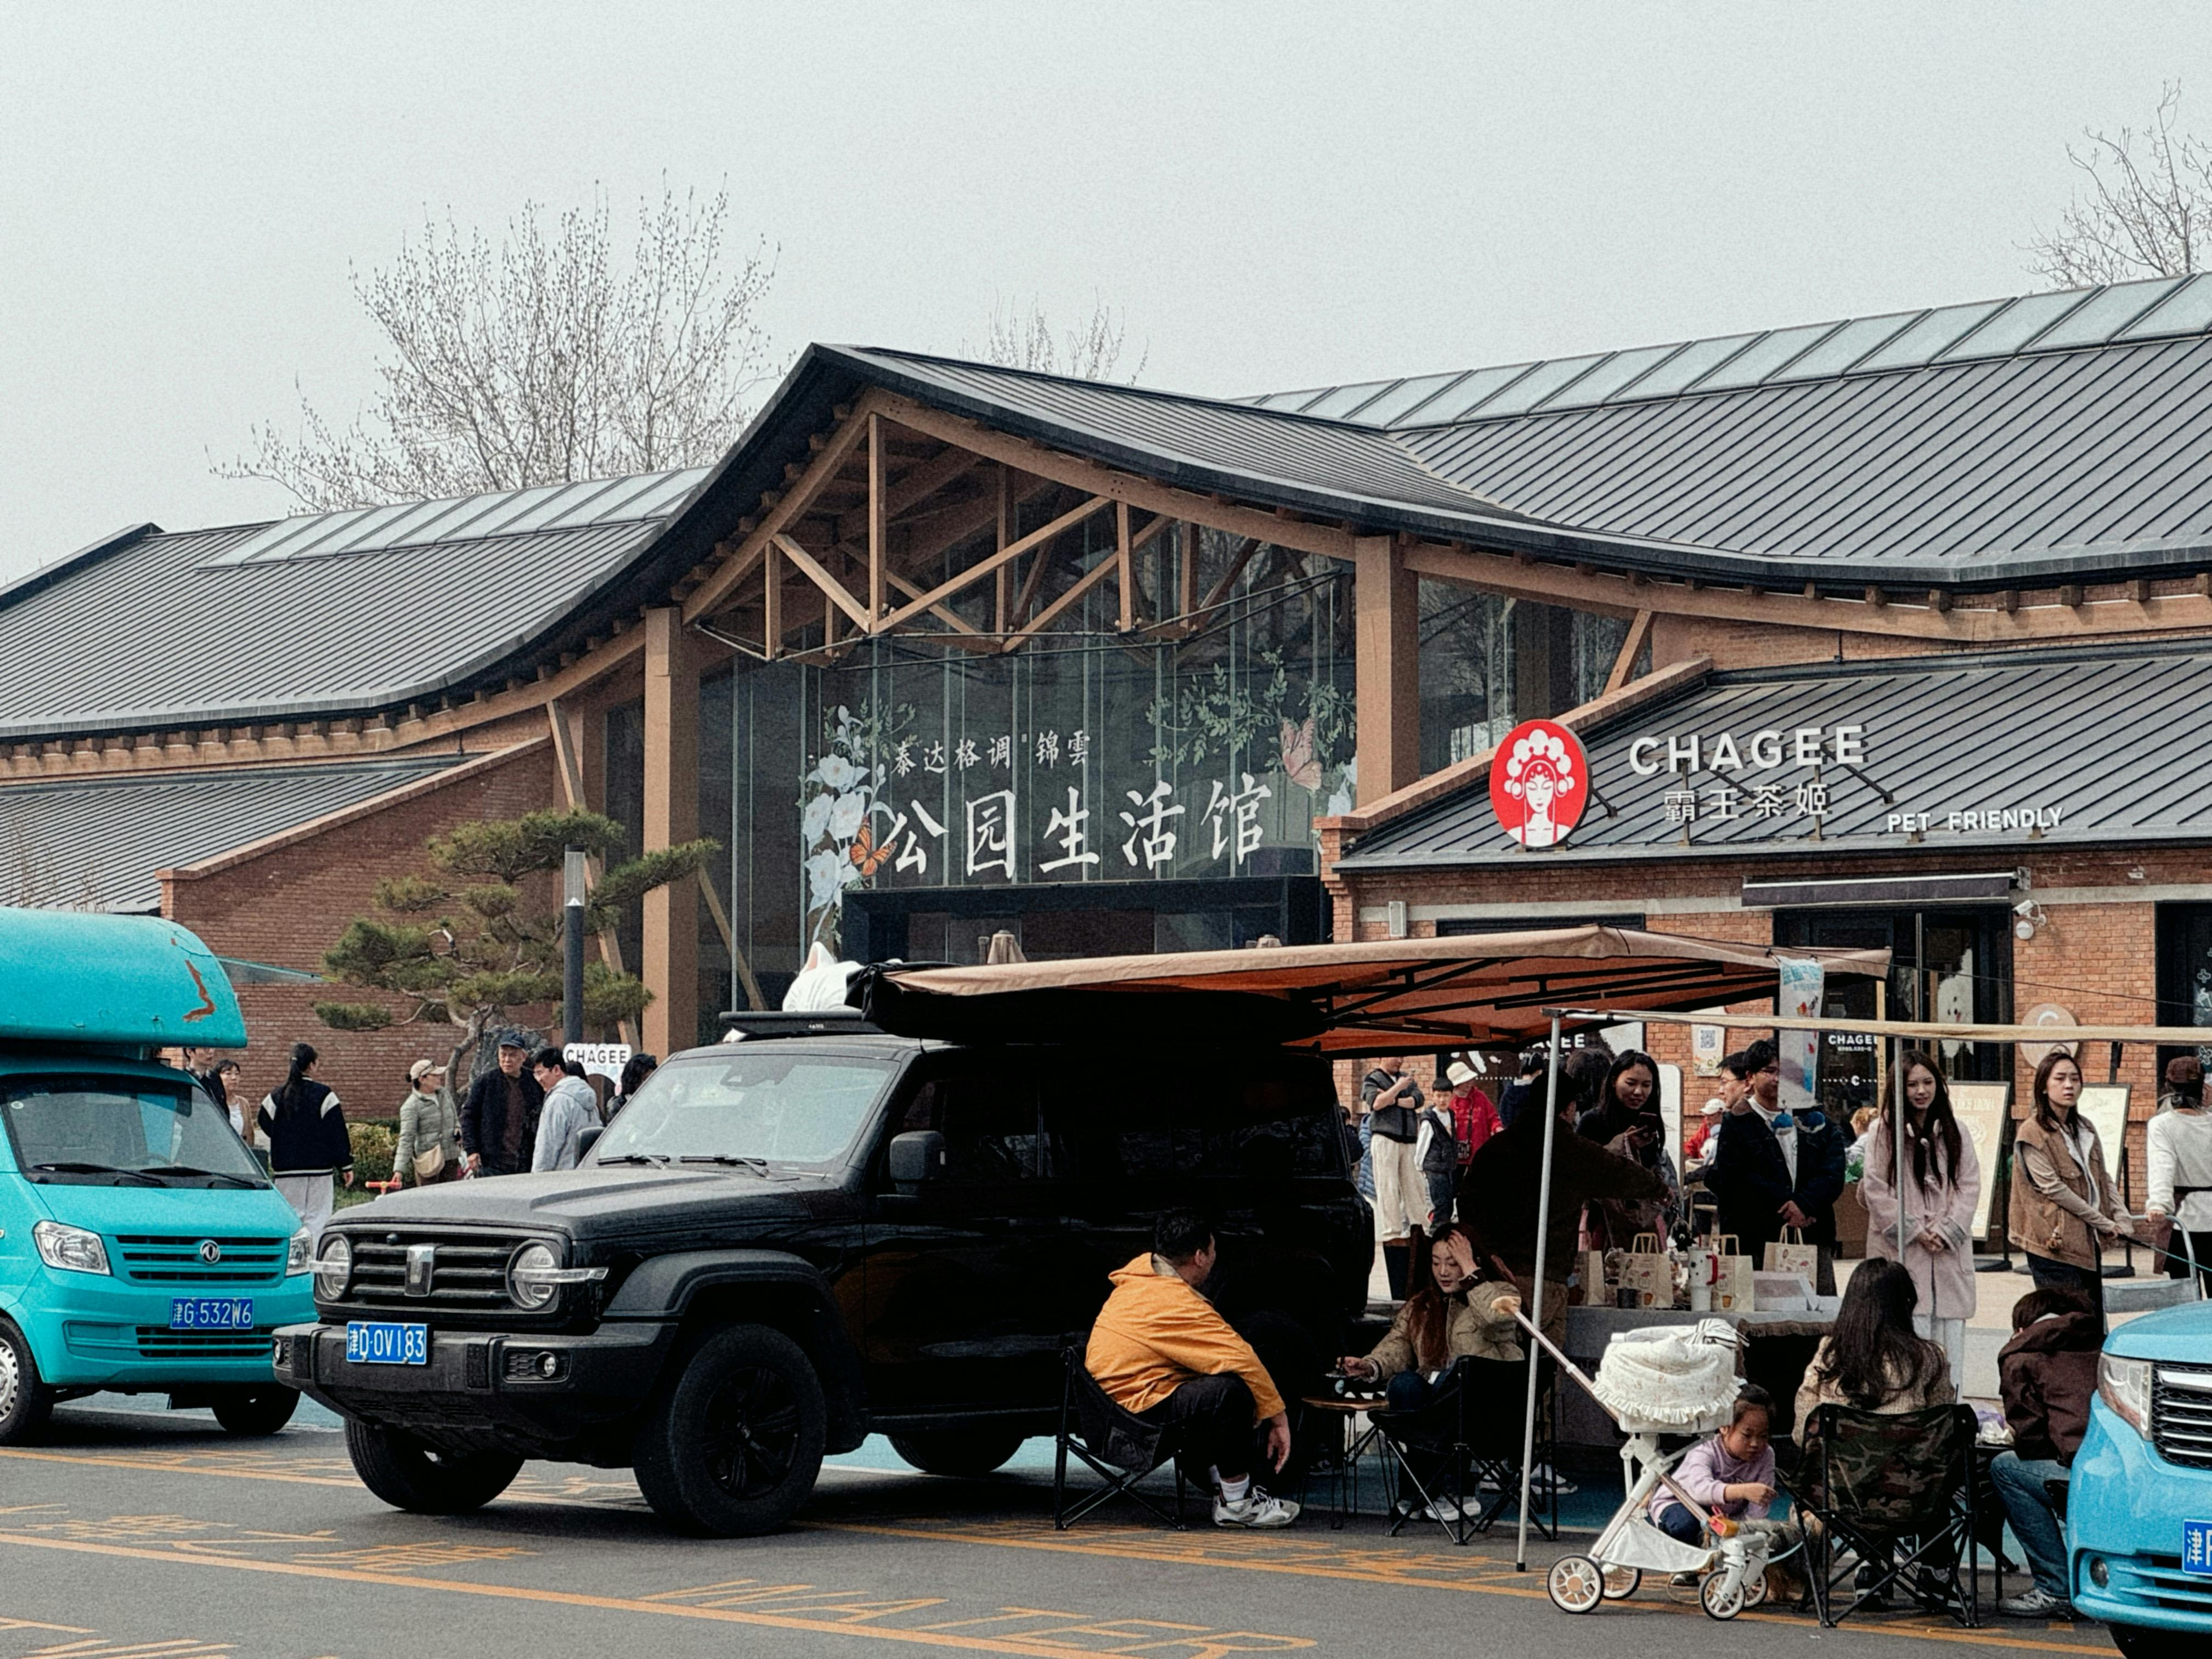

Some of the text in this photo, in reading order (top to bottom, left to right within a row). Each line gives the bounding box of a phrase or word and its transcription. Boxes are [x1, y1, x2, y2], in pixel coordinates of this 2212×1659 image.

[1629, 725, 1864, 775] CHAGEE
[1664, 782, 1829, 822] 霸王茶姬
[1887, 806, 2064, 833] PET FRIENDLY
[879, 772, 1272, 879] 公园生活馆
[566, 1049, 627, 1063] CHAGEE
[635, 1578, 1318, 1659] WATER
